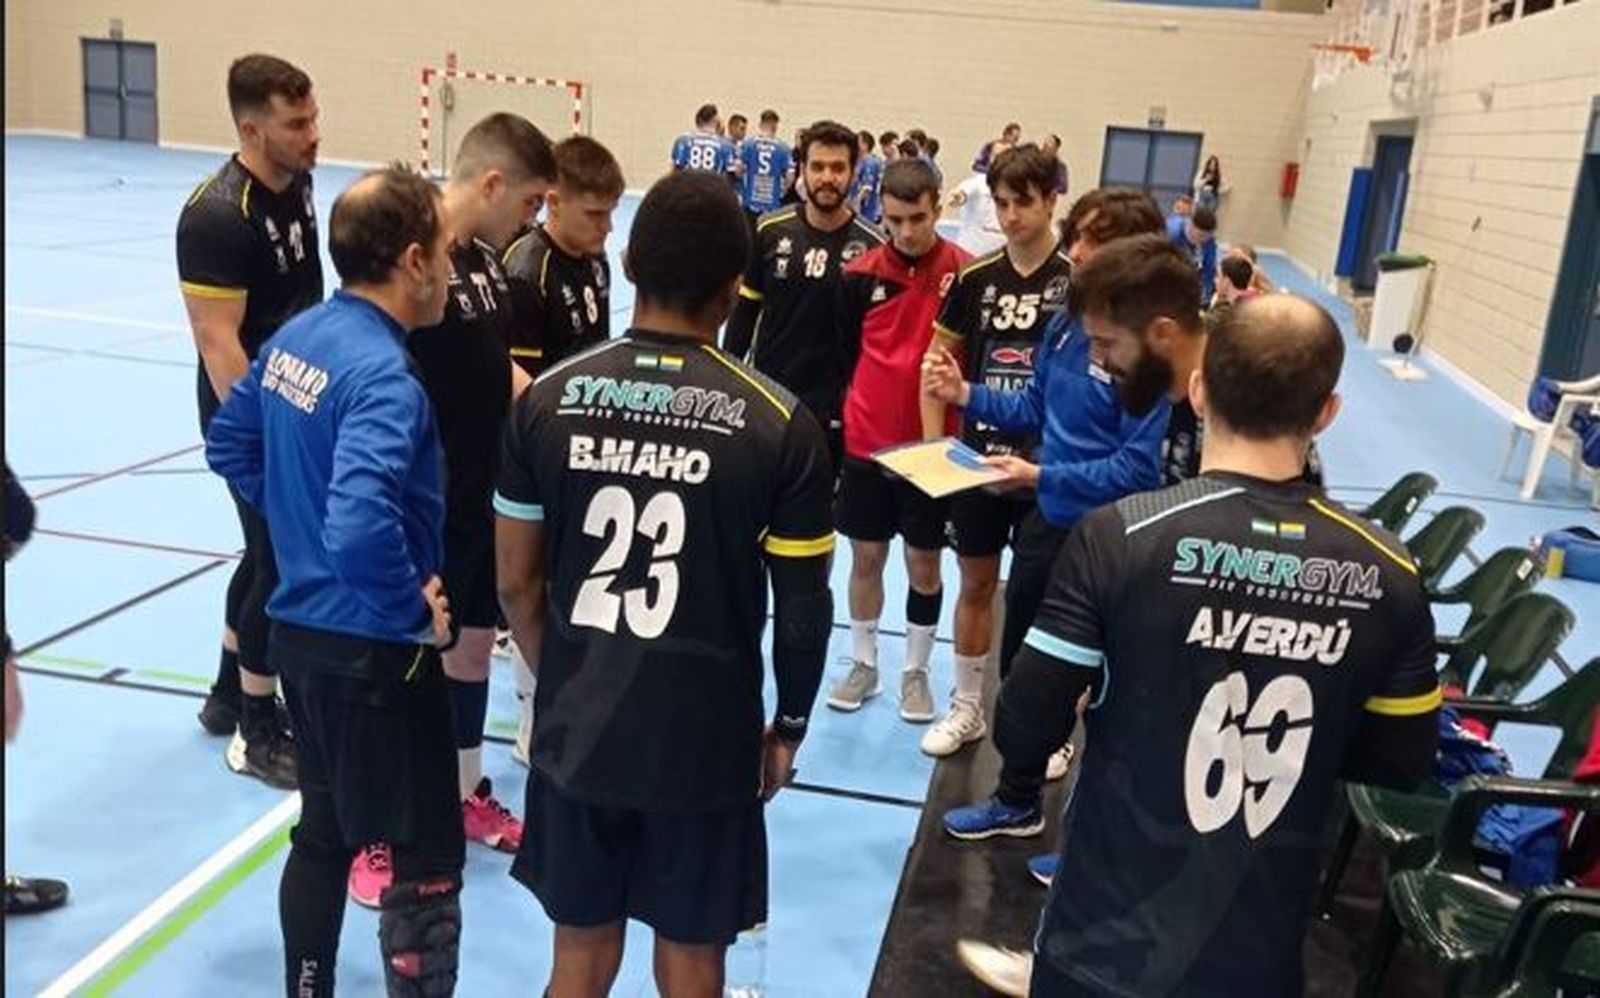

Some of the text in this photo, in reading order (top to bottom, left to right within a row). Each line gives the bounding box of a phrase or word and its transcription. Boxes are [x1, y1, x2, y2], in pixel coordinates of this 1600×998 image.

[690, 145, 716, 170] 88
[758, 151, 772, 174] 5
[584, 286, 598, 324] 8
[992, 294, 1041, 330] 35
[569, 435, 711, 485] B.MAHO
[570, 485, 686, 639] 23
[1184, 670, 1313, 839] 69
